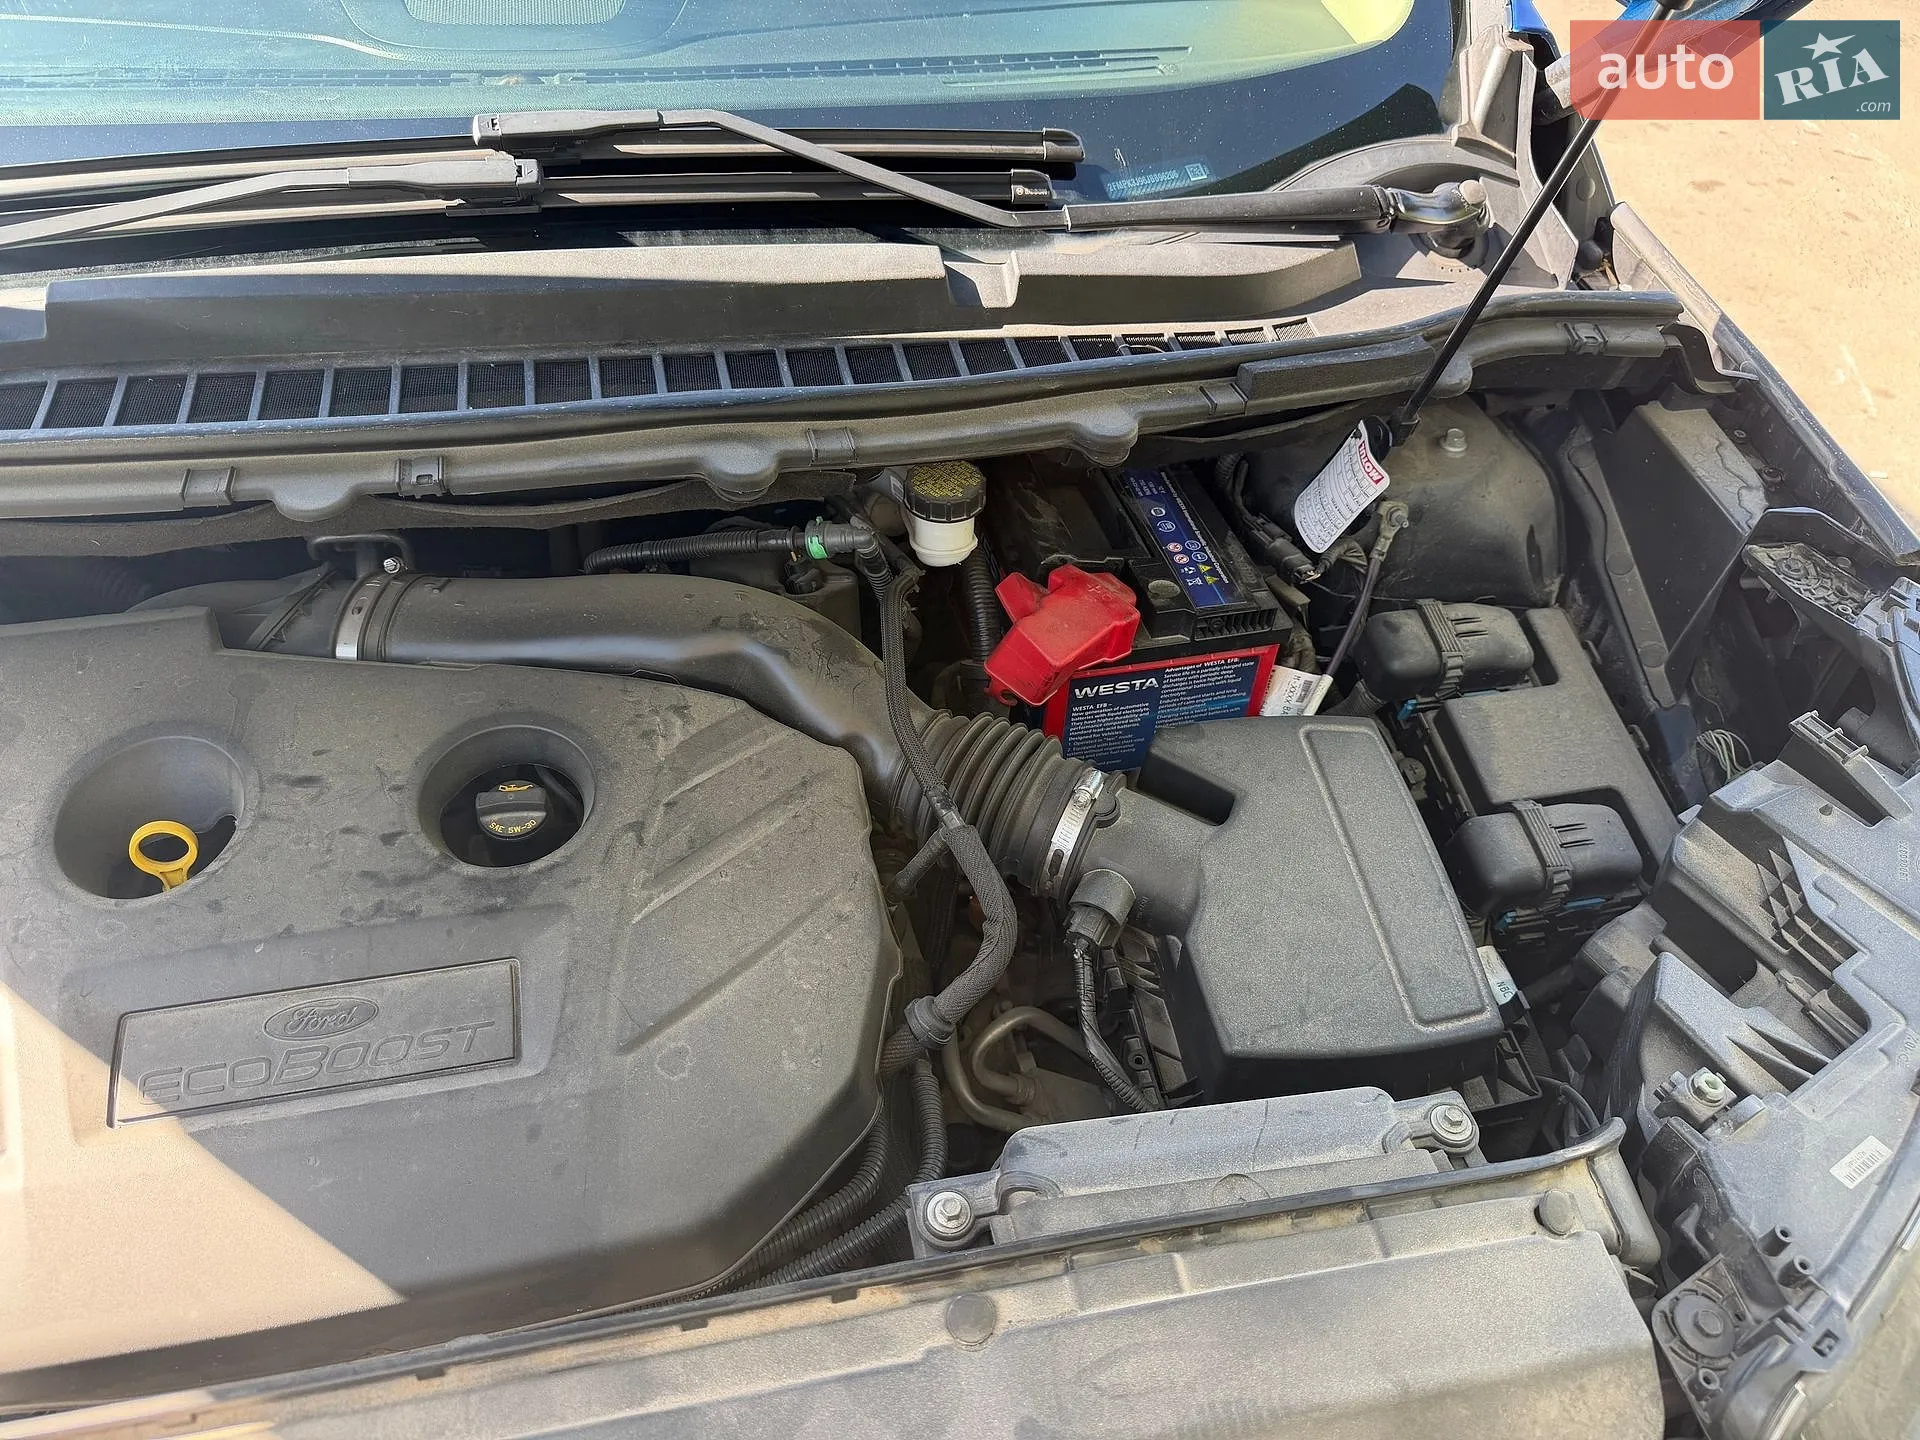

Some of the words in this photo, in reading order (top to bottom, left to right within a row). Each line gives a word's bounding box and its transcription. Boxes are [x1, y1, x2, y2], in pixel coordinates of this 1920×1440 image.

[1358, 442, 1383, 483] MOTUL
[1074, 677, 1159, 698] WESTA
[488, 821, 505, 833] SAE
[508, 819, 537, 834] 5W-30
[1496, 981, 1513, 998] NBC
[284, 1005, 357, 1036] Ford
[137, 1021, 495, 1106] ECOBOOST
